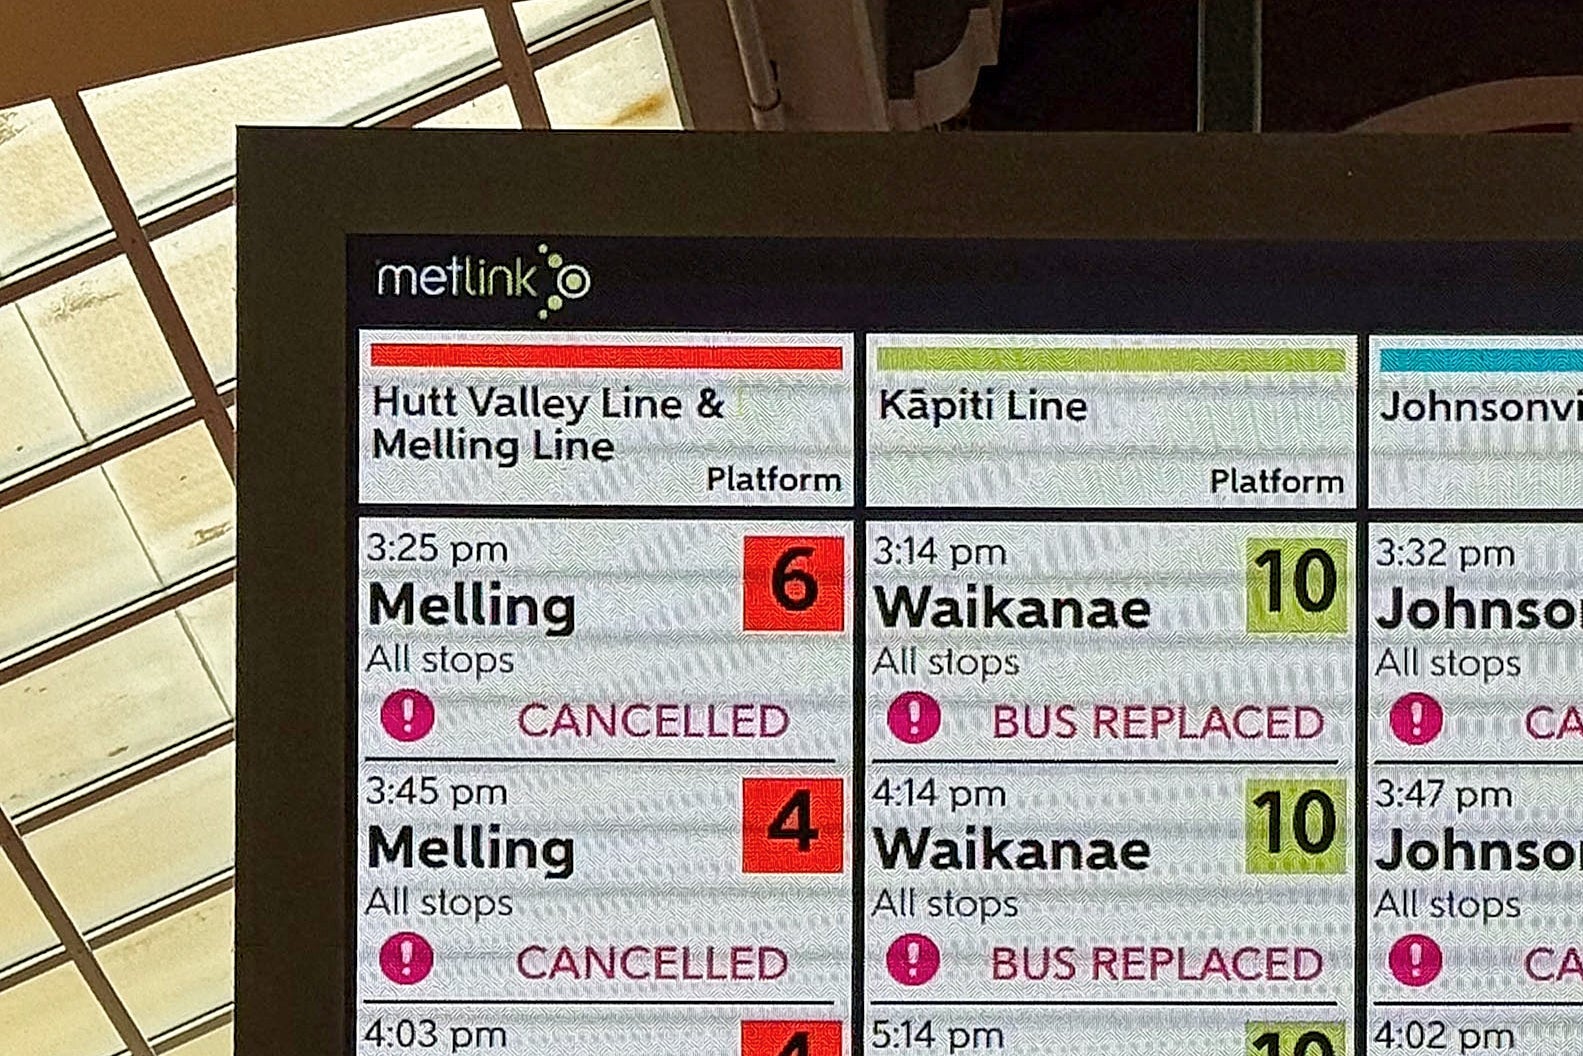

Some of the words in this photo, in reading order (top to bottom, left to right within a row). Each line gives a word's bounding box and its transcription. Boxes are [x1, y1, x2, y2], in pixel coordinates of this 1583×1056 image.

[378, 257, 535, 295] metlink
[374, 386, 457, 416] Hutt
[474, 386, 589, 425] Valley
[603, 386, 681, 419] Line
[698, 387, 723, 418] &
[881, 388, 993, 428] Kāpiti
[1009, 388, 1087, 421] Line
[374, 427, 518, 467] Melling
[535, 428, 614, 462] Line
[708, 466, 841, 491] Platform
[1212, 468, 1343, 493] Platform
[368, 533, 438, 561] 3:25
[451, 542, 507, 567] pm
[874, 536, 937, 564] 3:14
[950, 544, 1006, 570] pm
[1377, 538, 1446, 566] 3:32
[1460, 546, 1514, 572] pm
[773, 548, 817, 611] 6
[1256, 549, 1336, 612] 10
[370, 581, 574, 636] Melling
[874, 584, 1150, 629] Waikanae
[366, 643, 409, 672] All
[423, 646, 514, 680] stops
[872, 646, 916, 674] All
[929, 648, 1019, 683] stops
[1375, 647, 1418, 675] All
[1431, 650, 1521, 683] stops
[519, 702, 789, 737] CANCELLED
[995, 704, 1076, 738] BUS
[1095, 705, 1324, 739] REPLACED
[367, 776, 438, 804] 3:45
[451, 785, 507, 810] pm
[873, 778, 937, 806] 4:14
[949, 786, 1005, 812] pm
[1376, 779, 1444, 807] 3:47
[1456, 787, 1512, 813] pm
[768, 791, 818, 851] 4
[1254, 790, 1336, 854] 10
[369, 824, 573, 879] Melling
[873, 825, 1150, 870] Waikanae
[365, 886, 408, 914] All
[422, 888, 512, 923] stops
[871, 888, 915, 916] All
[928, 890, 1018, 924] stops
[1374, 889, 1417, 917] All
[1431, 891, 1520, 925] stops
[517, 945, 788, 979] CANCELLED
[993, 947, 1075, 980] BUS
[1093, 947, 1323, 980] REPLACED
[364, 1018, 437, 1047] 4:03
[451, 1027, 506, 1053] pm
[873, 1020, 935, 1048] 5:14
[948, 1028, 1003, 1054] pm
[1374, 1020, 1446, 1049] 4:02
[1459, 1029, 1514, 1055] pm
